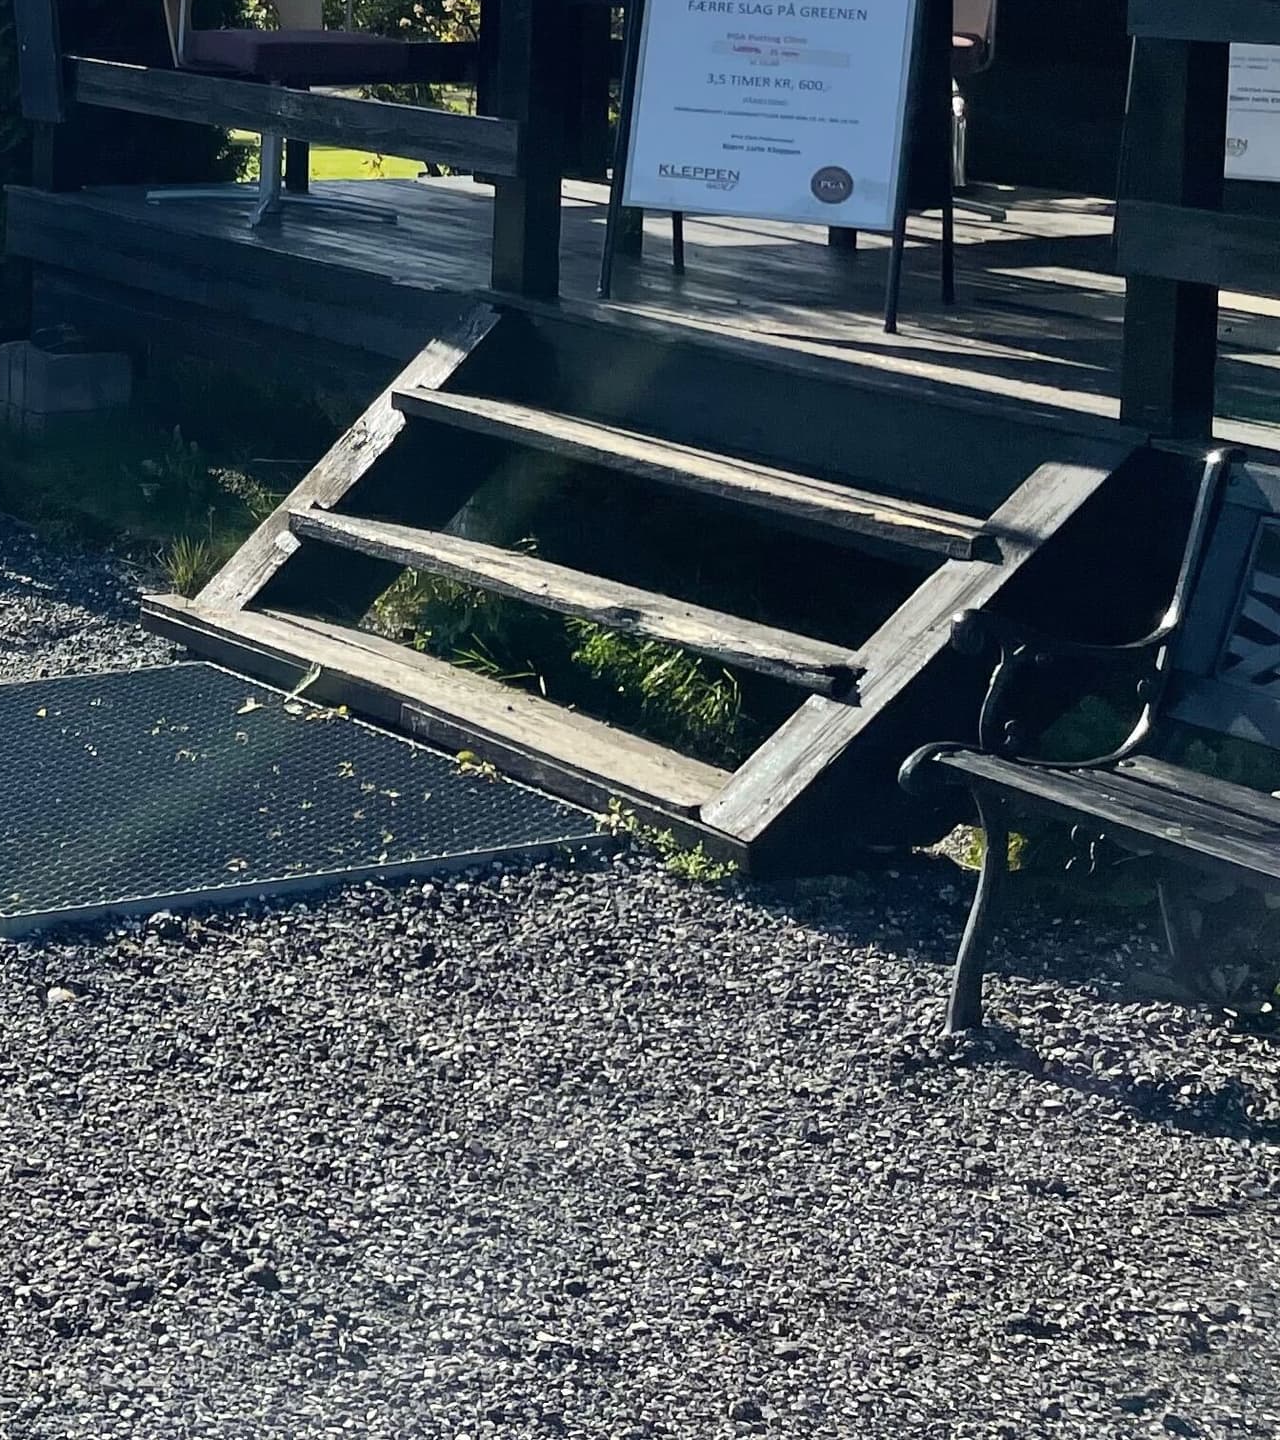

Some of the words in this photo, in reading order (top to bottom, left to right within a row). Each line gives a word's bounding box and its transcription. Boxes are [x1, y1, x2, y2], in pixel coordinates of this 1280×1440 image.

[687, 0, 734, 14] FÆRRE
[738, 2, 773, 16] SLAG
[777, 2, 796, 17] PÅ
[800, 7, 868, 21] GREENEN
[706, 72, 726, 85] 3,5
[730, 74, 771, 88] TIMER
[657, 163, 741, 181] KLEPPEN
[819, 179, 845, 192] PGA
